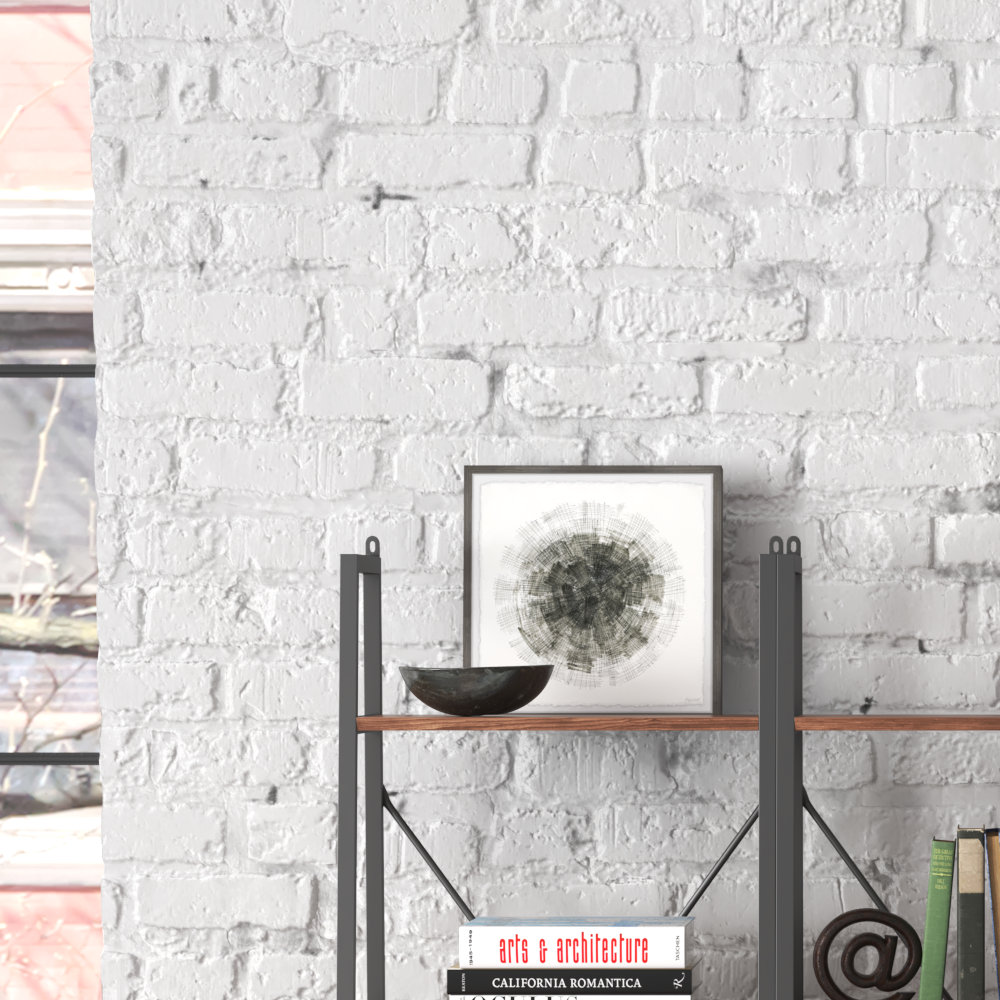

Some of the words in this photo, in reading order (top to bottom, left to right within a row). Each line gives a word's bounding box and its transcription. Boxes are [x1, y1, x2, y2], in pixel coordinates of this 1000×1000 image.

[499, 933, 528, 964] arts
[539, 938, 548, 964] &
[557, 931, 648, 964] architecture
[492, 977, 567, 989] CALIFORNIA
[570, 977, 642, 989] ROMANTICA
